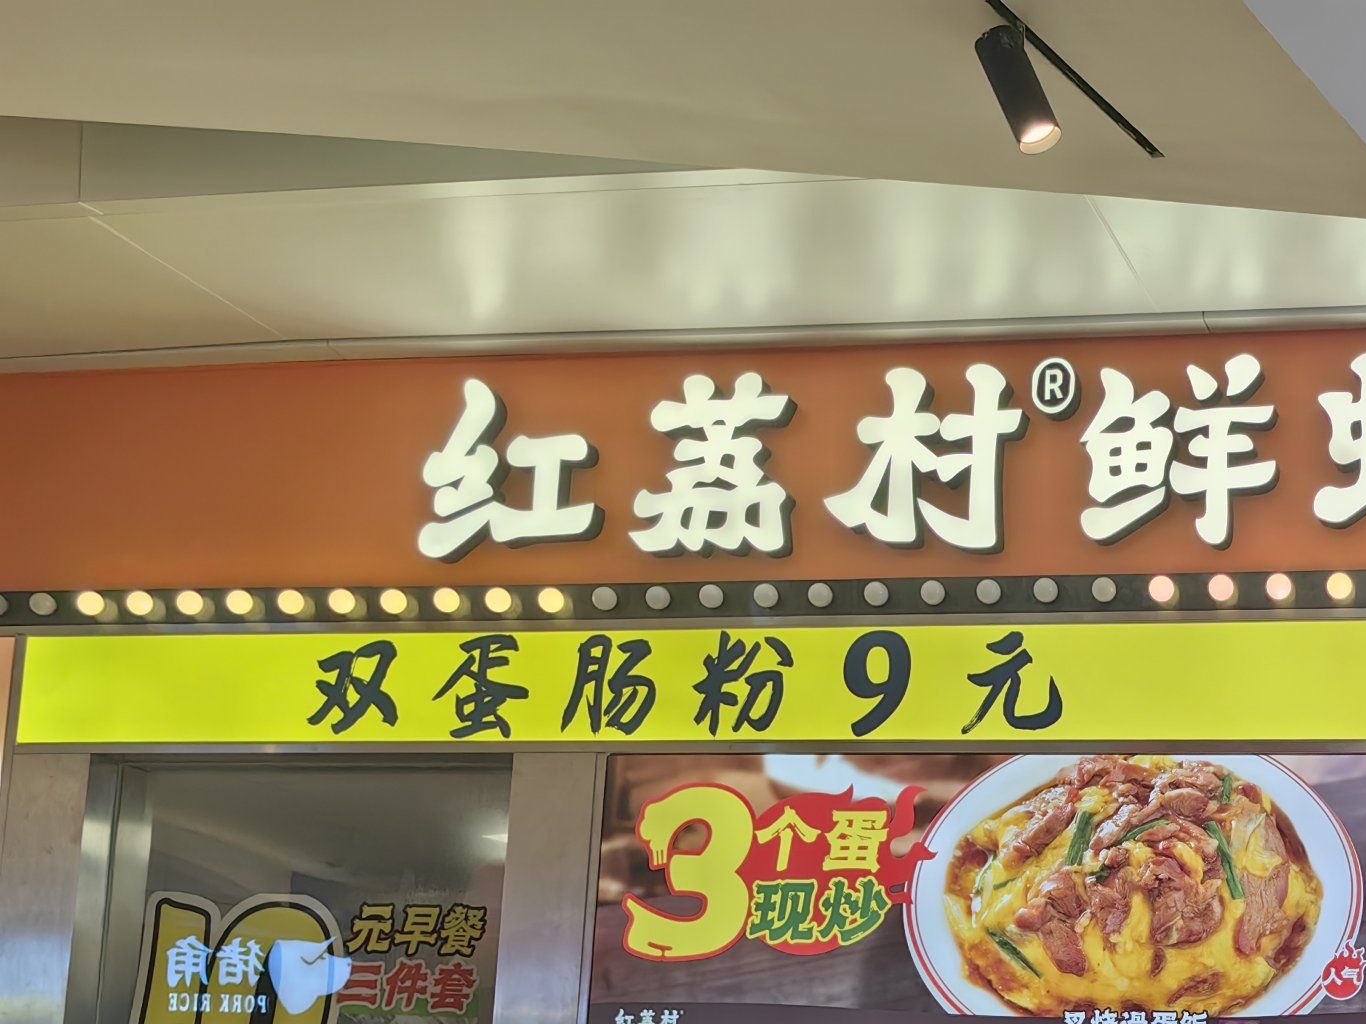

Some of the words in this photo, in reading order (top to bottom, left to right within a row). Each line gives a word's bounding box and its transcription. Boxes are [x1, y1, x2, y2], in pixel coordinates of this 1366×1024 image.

[755, 806, 889, 873] 个蛋
[347, 902, 487, 957] 元早餐
[747, 876, 891, 946] 现炒
[336, 958, 478, 1013] 三件套
[1323, 967, 1361, 986] 人气
